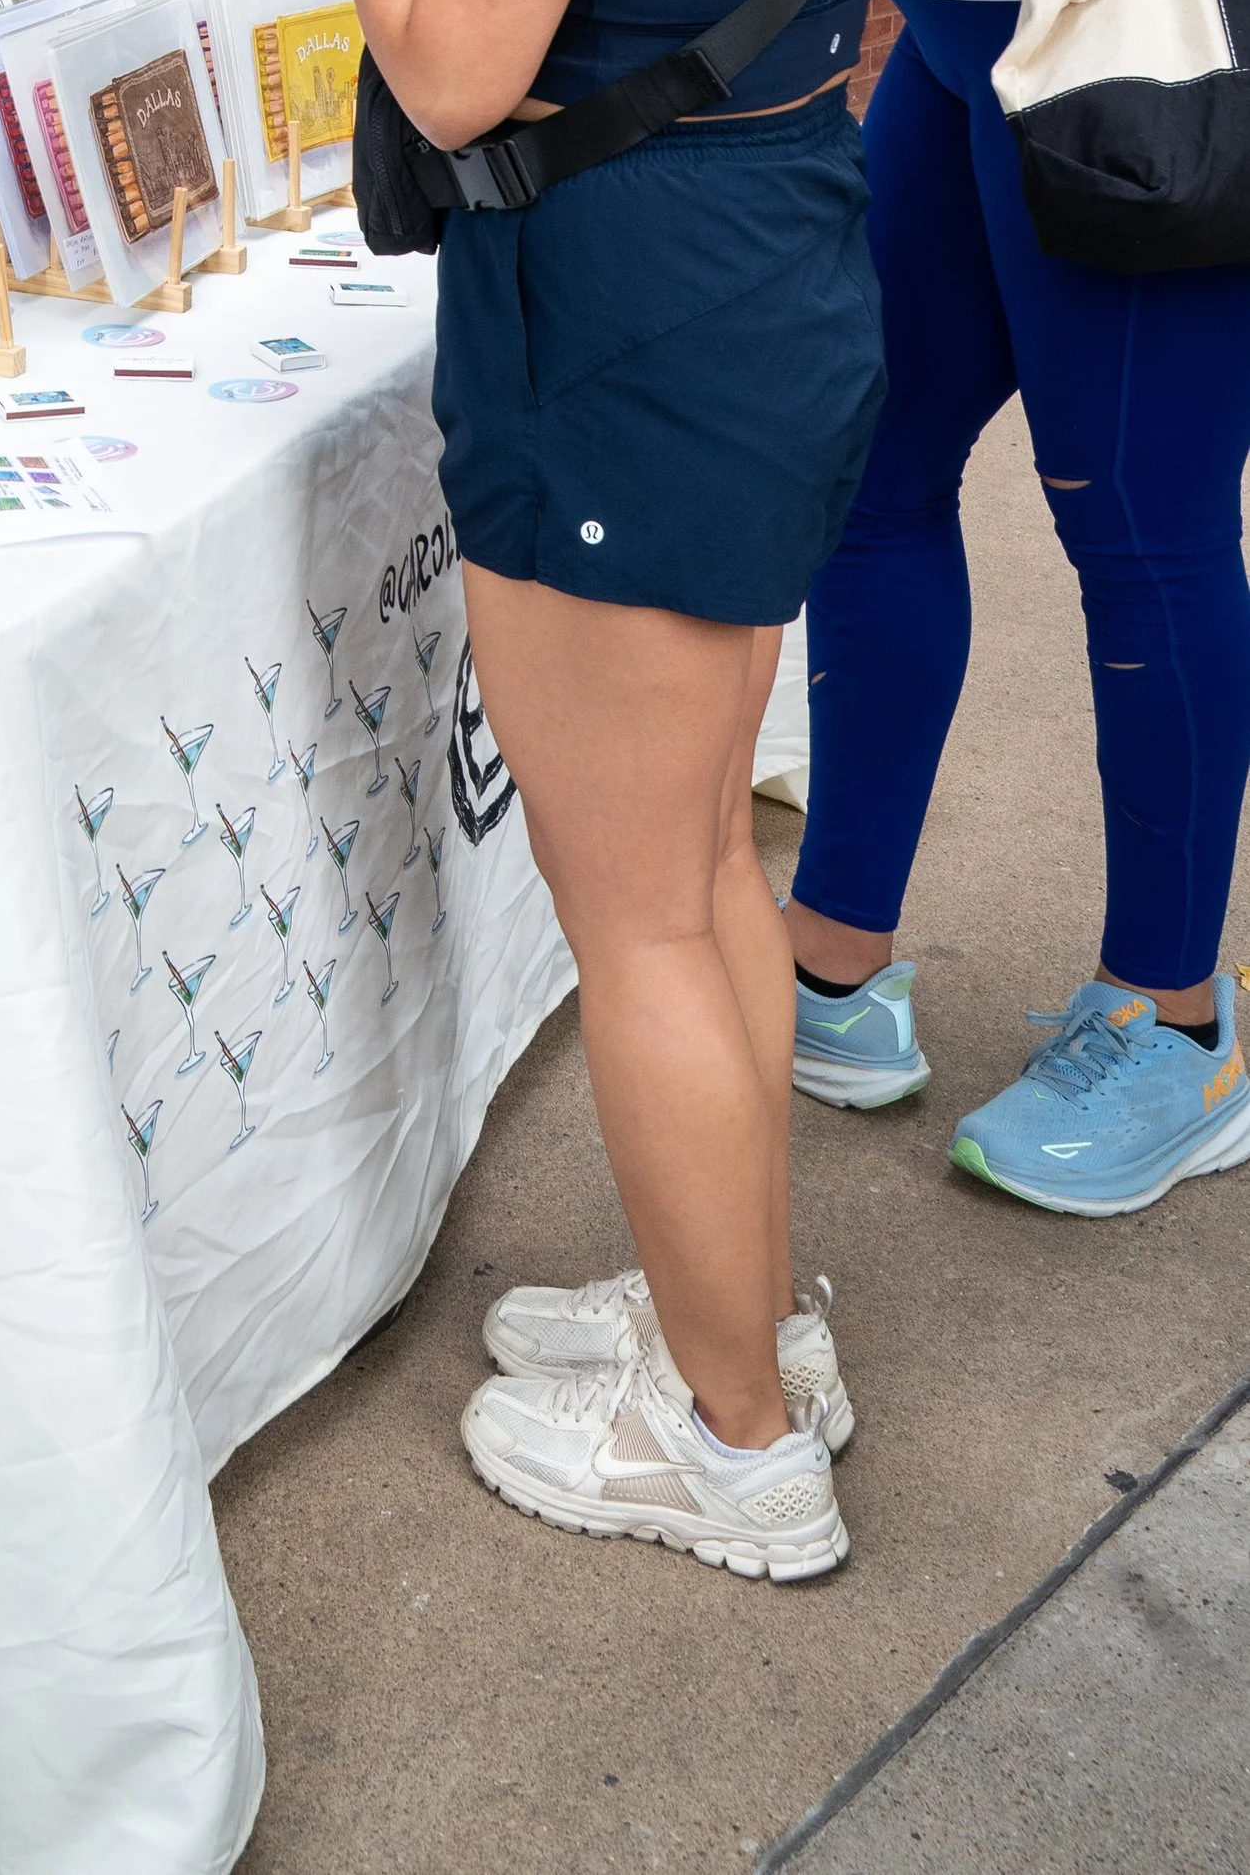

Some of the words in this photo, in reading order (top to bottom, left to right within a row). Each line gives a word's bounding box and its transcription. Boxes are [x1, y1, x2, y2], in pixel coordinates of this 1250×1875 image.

[296, 32, 350, 63] DALLAS
[136, 88, 181, 128] DALLAS
[380, 511, 461, 623] @CAROL
